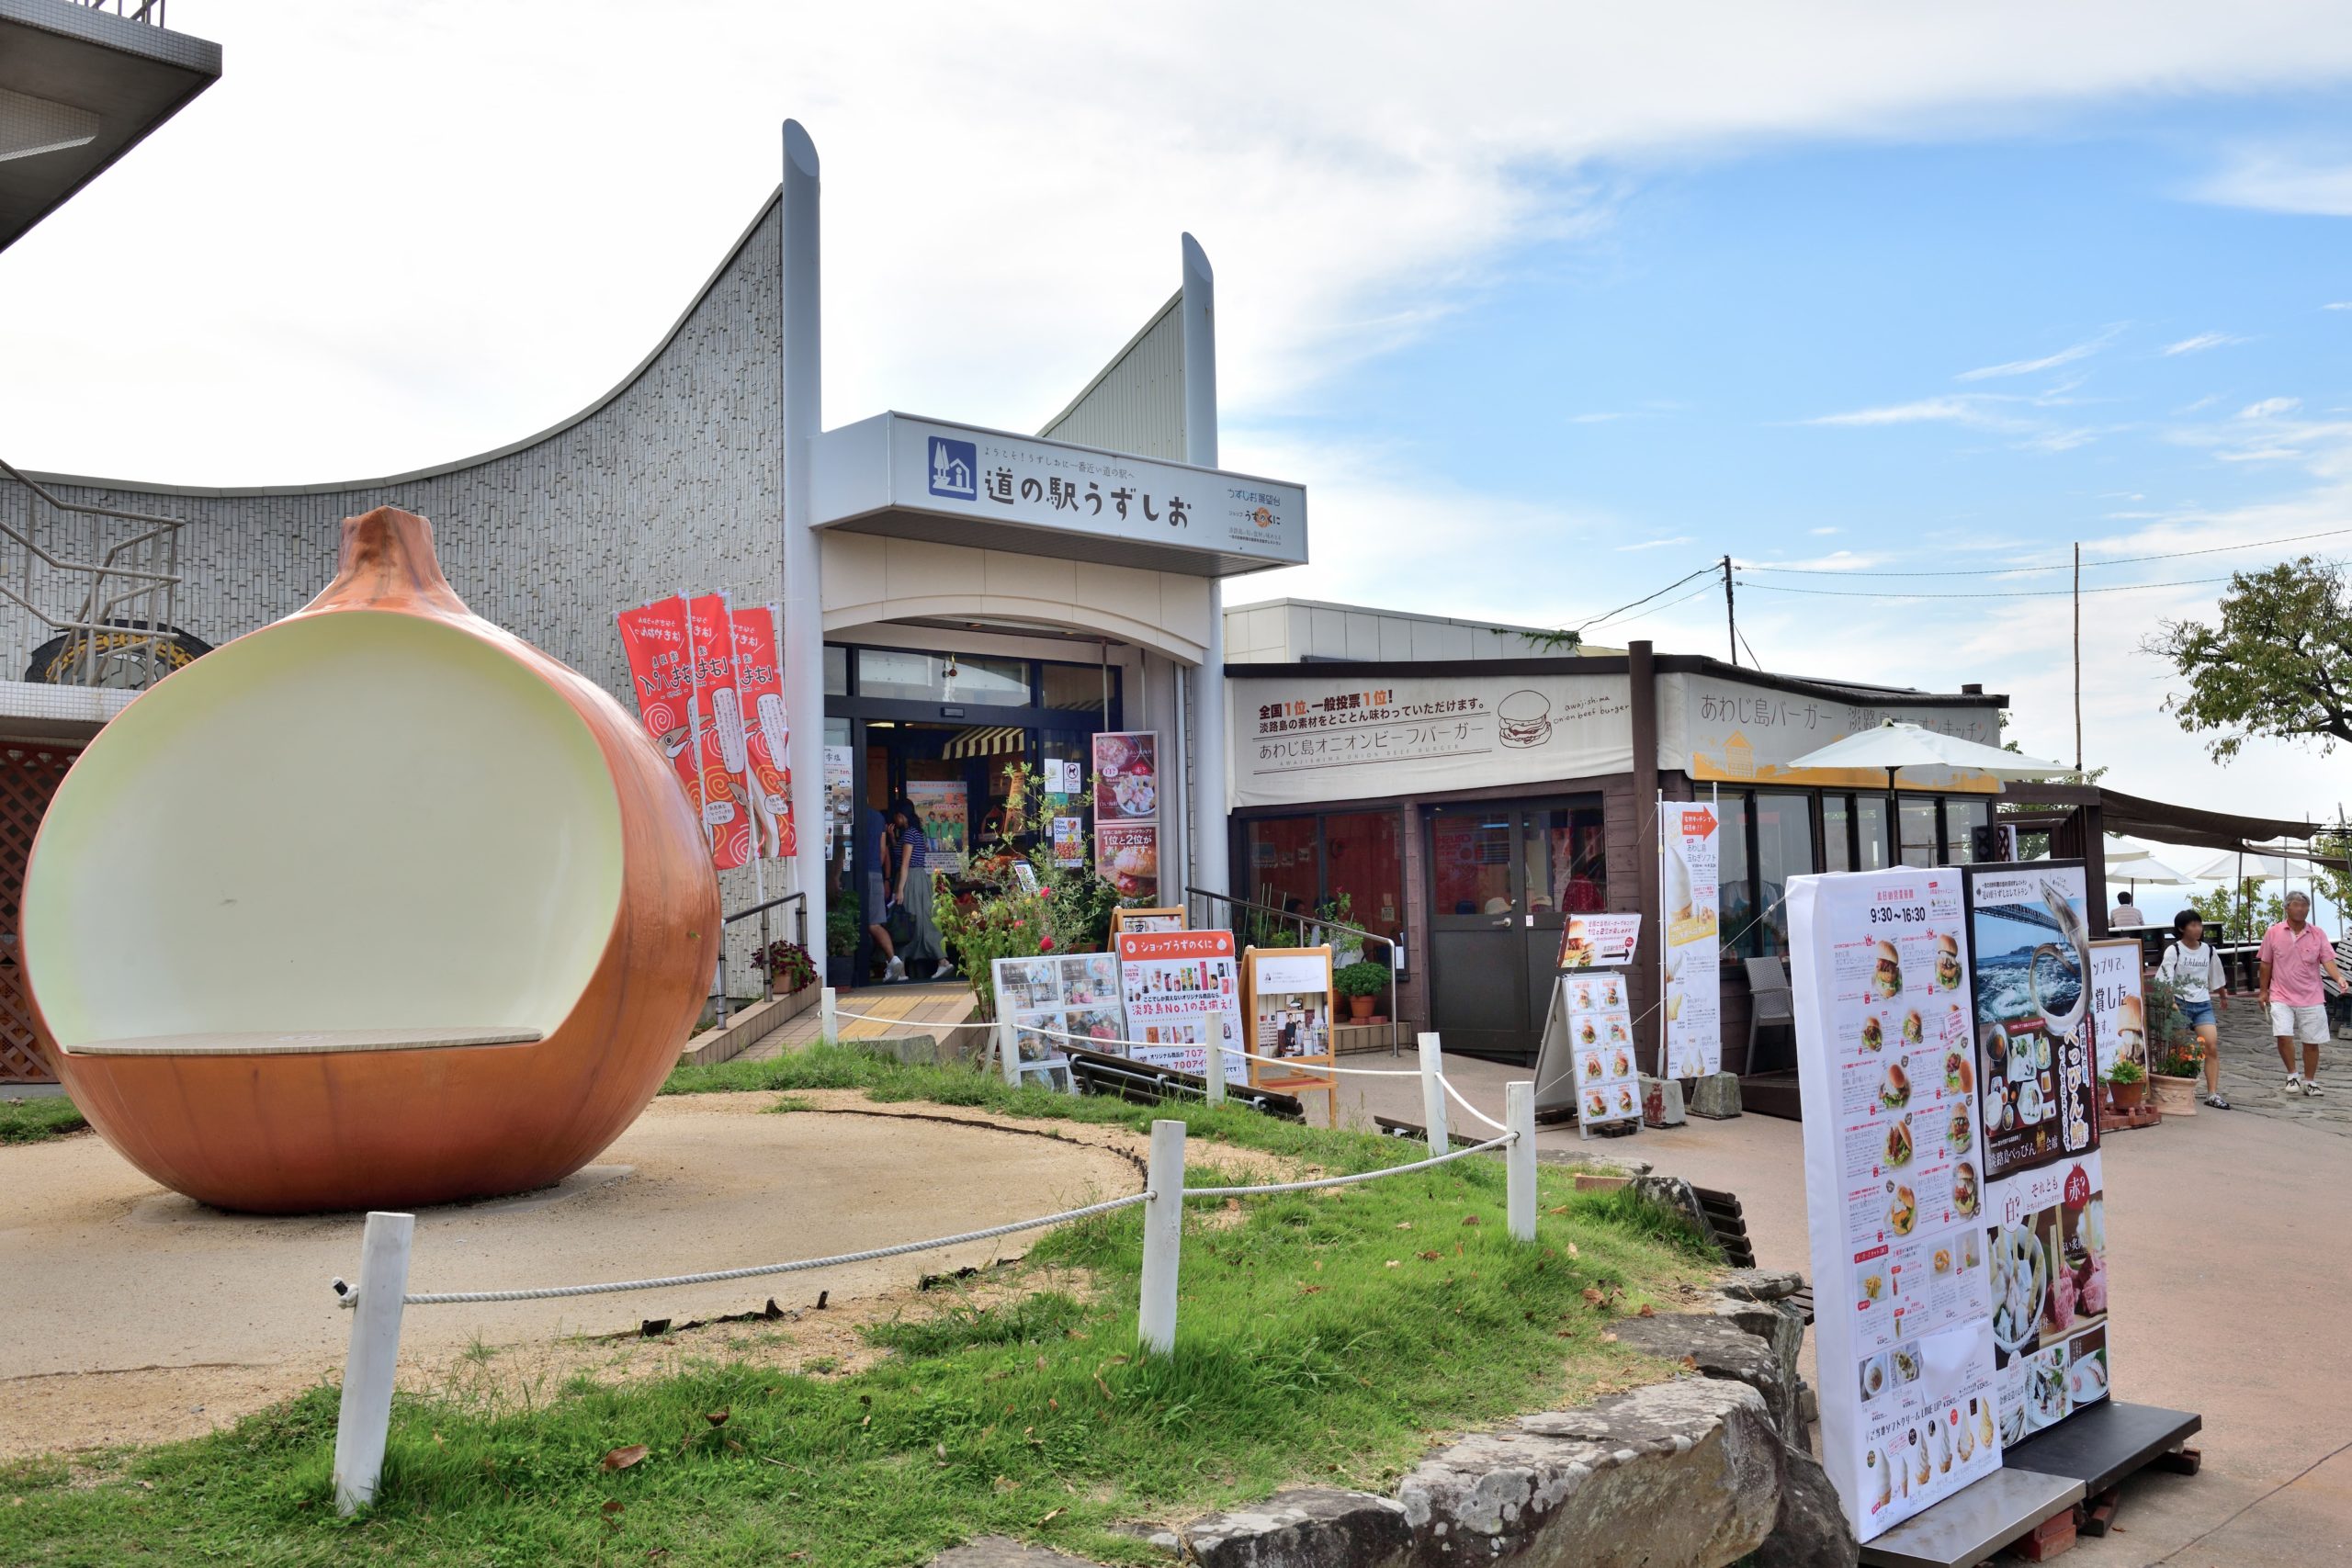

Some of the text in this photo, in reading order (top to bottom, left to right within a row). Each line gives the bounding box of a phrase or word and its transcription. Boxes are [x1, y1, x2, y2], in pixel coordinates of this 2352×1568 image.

[985, 467, 1192, 529] 道の駅うずしお
[1259, 689, 1394, 720] 全国1位、一般投票1位!
[1259, 697, 1486, 734] 淡路島の素材をとことん味わっていただけます。
[1565, 695, 1611, 712] awajishima
[1577, 707, 1597, 719] beef
[1600, 704, 1631, 715] burger
[1700, 694, 1834, 730] あわじ島バーガー
[1259, 722, 1485, 761] あわじ島オニオンビーフバーガー
[1279, 742, 1461, 767] AWAJISHIMA ONION BEEF BURGER
[1103, 834, 1152, 846] 1位と2位が
[1140, 938, 1213, 953] ショップうずのくに
[1131, 998, 1233, 1016] 淡路島No.1の品揃え!
[2096, 983, 2127, 1014] 賞した
[2031, 1175, 2059, 1198] それとも
[2068, 1176, 2086, 1203] 赤?
[2006, 1195, 2020, 1224] 白?
